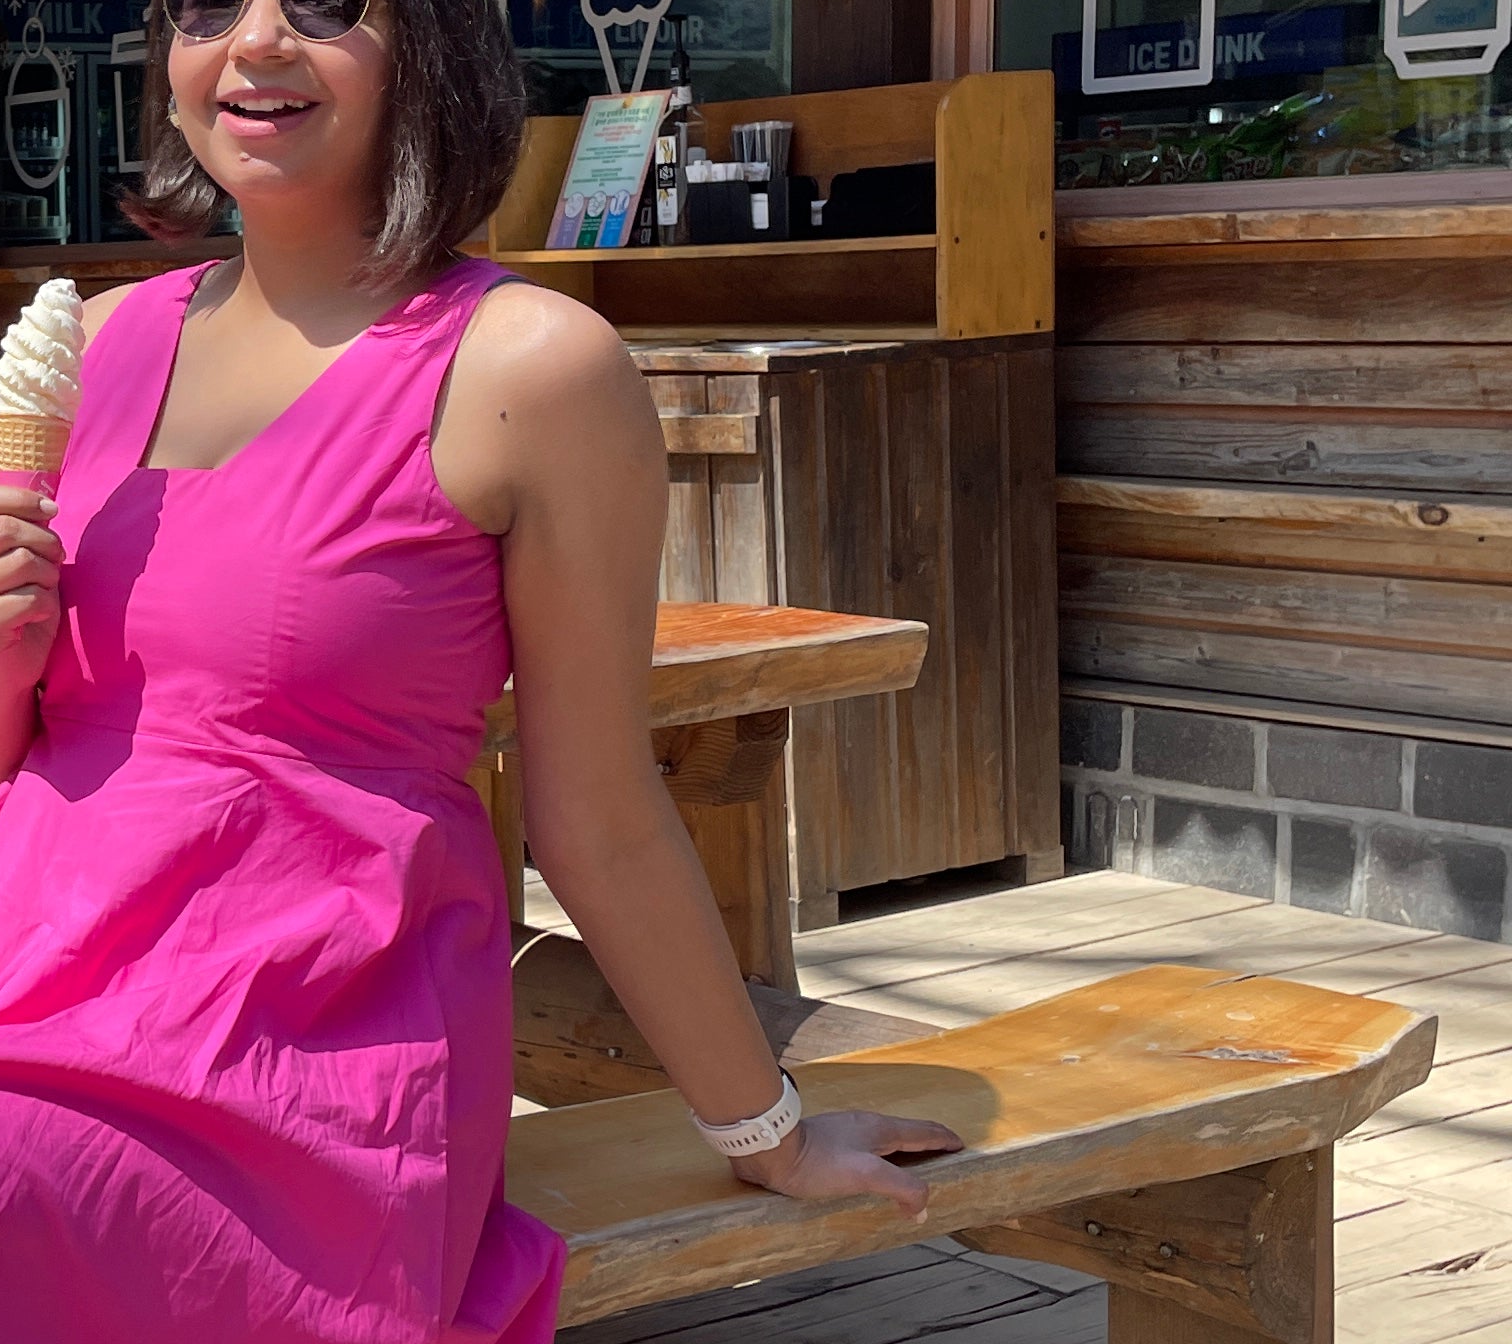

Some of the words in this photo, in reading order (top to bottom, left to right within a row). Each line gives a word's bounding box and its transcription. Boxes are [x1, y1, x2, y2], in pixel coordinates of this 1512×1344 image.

[27, 1, 104, 34] MILK
[1128, 40, 1171, 73] ICE
[1177, 31, 1266, 70] DINK
